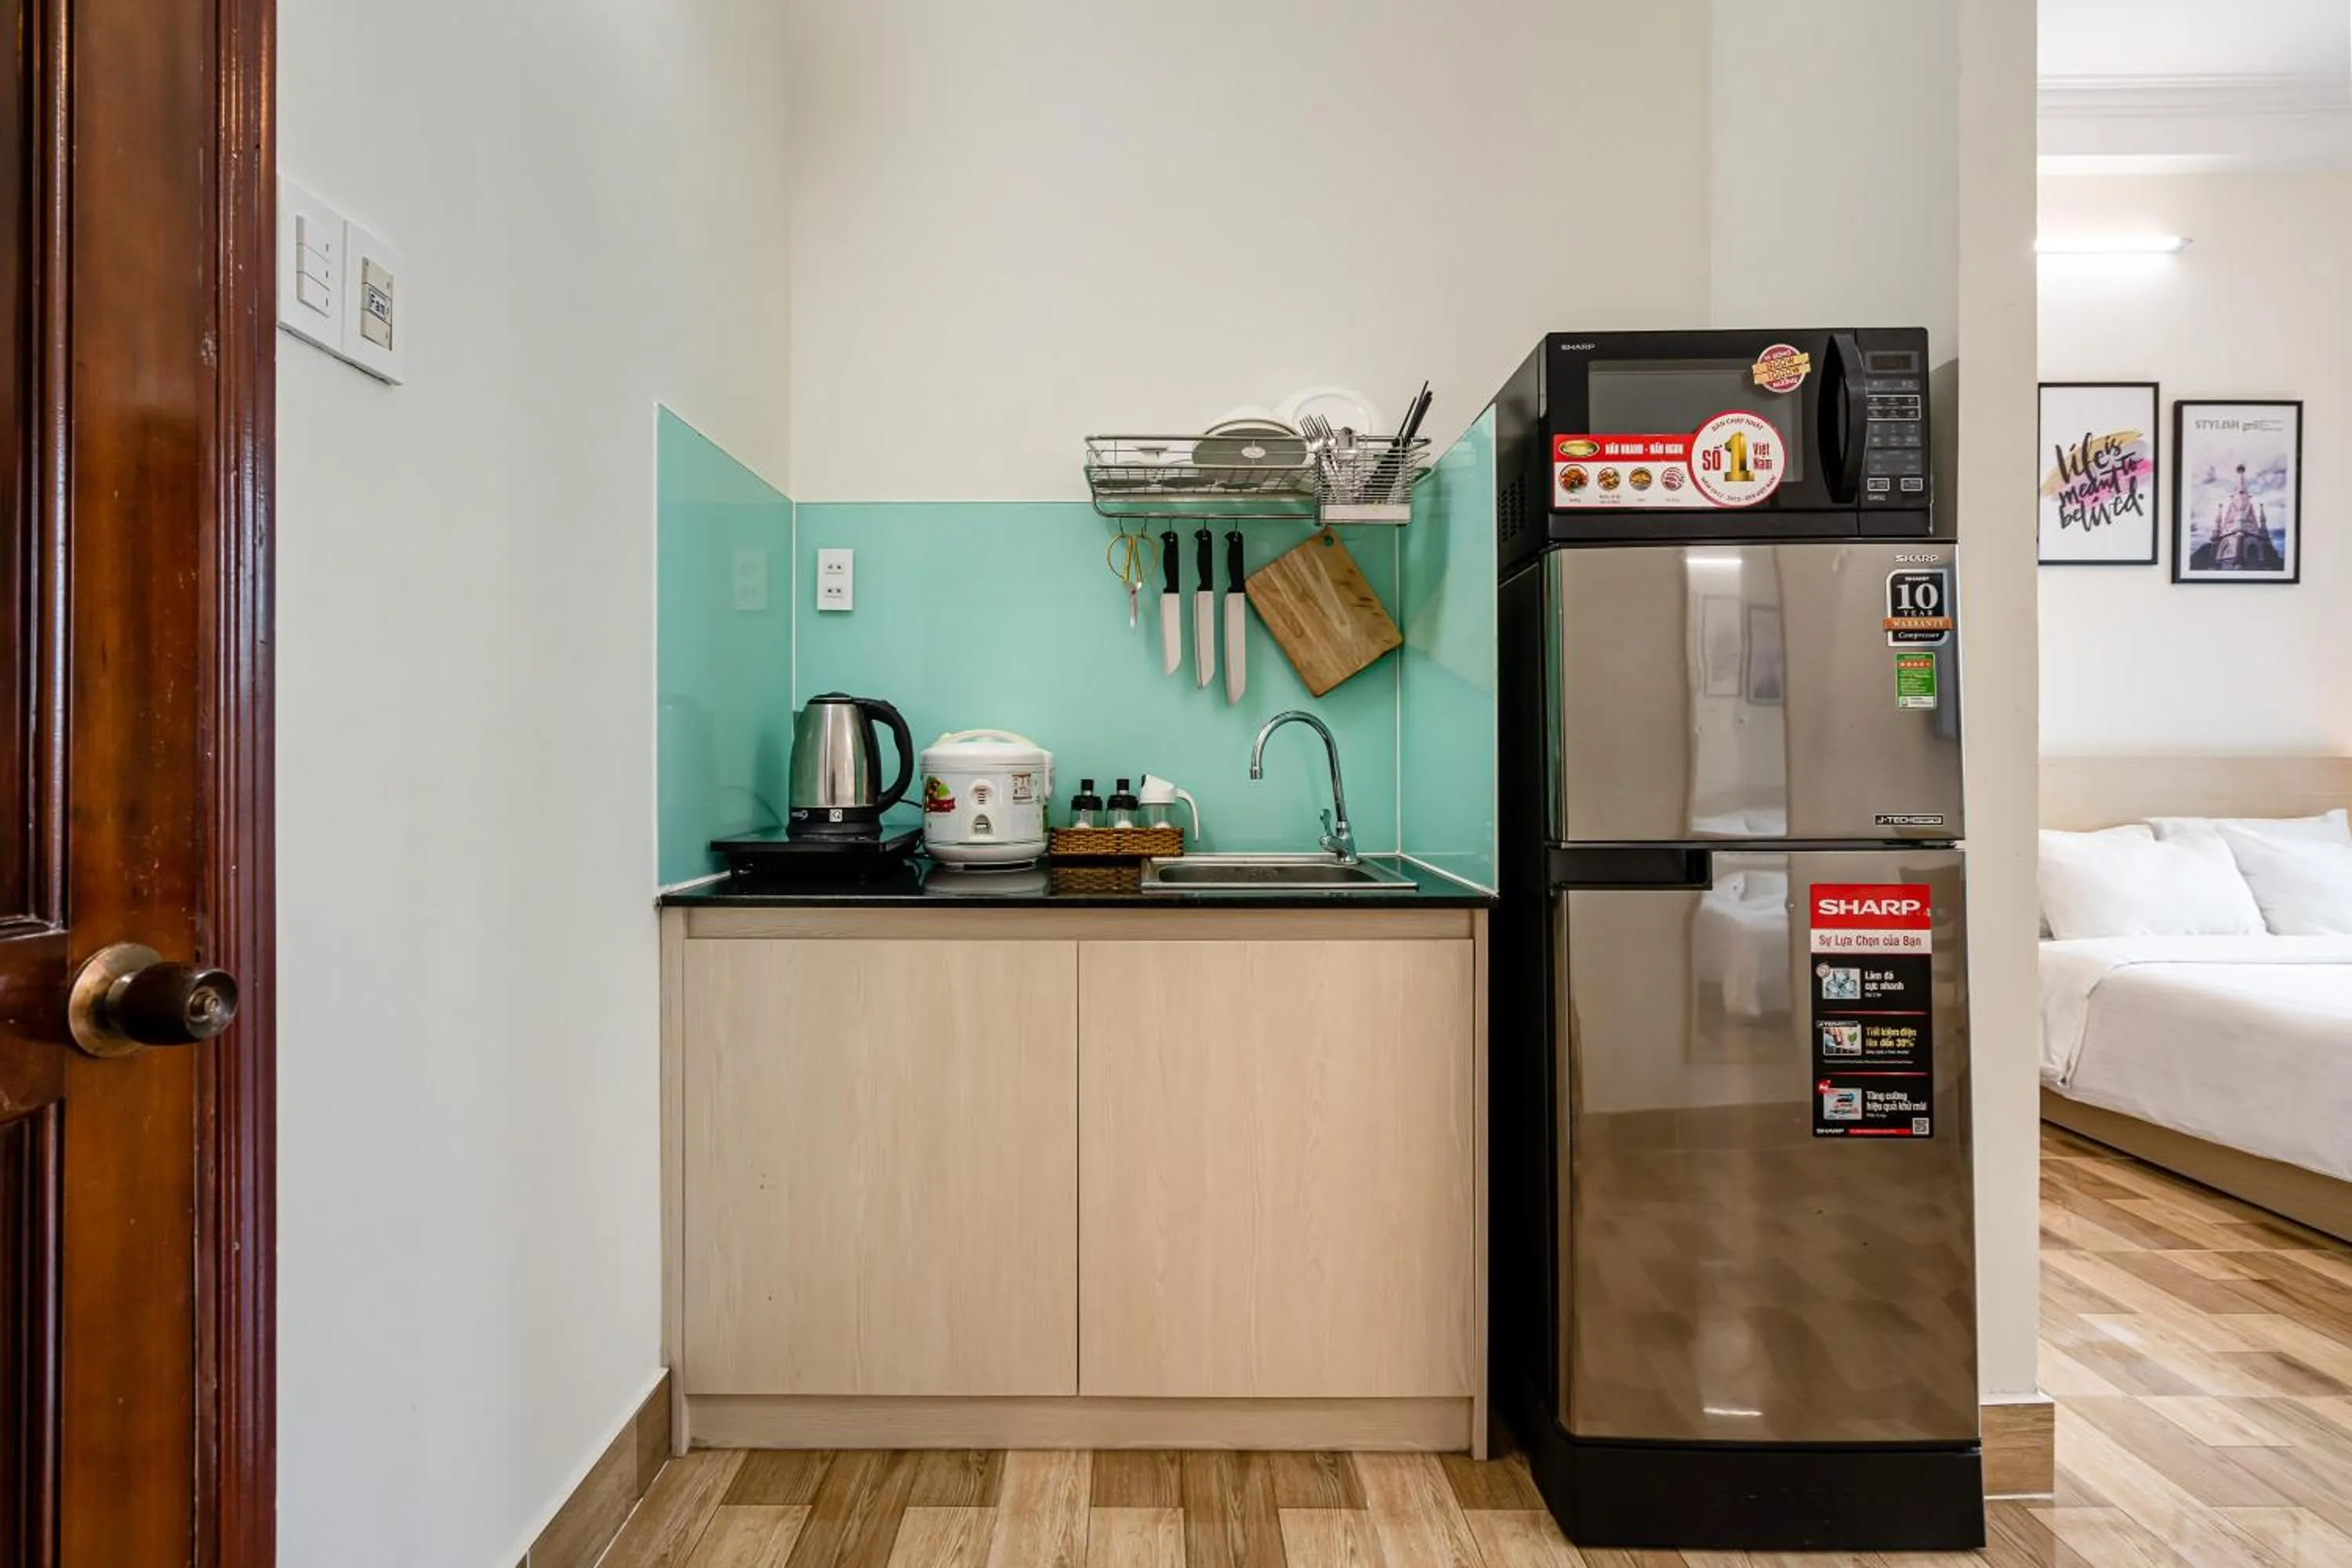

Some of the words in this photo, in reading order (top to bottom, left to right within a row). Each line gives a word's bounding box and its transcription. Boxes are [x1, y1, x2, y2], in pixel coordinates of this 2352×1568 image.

[2194, 419, 2240, 430] STYLISH
[1702, 445, 1722, 471] SỐ
[1724, 430, 1755, 482] 1
[1753, 458, 1773, 470] Nam
[2058, 465, 2122, 506] meant
[1896, 583, 1939, 610] 10
[1893, 619, 1945, 629] WARRANTY
[1818, 899, 1921, 916] SHARP
[1818, 934, 1833, 948] Sự
[1835, 935, 1853, 947] Lựa
[1856, 935, 1880, 947] Chọn
[1882, 934, 1900, 947] của
[1903, 935, 1922, 947] Bạn
[1880, 982, 1904, 990] nhanh
